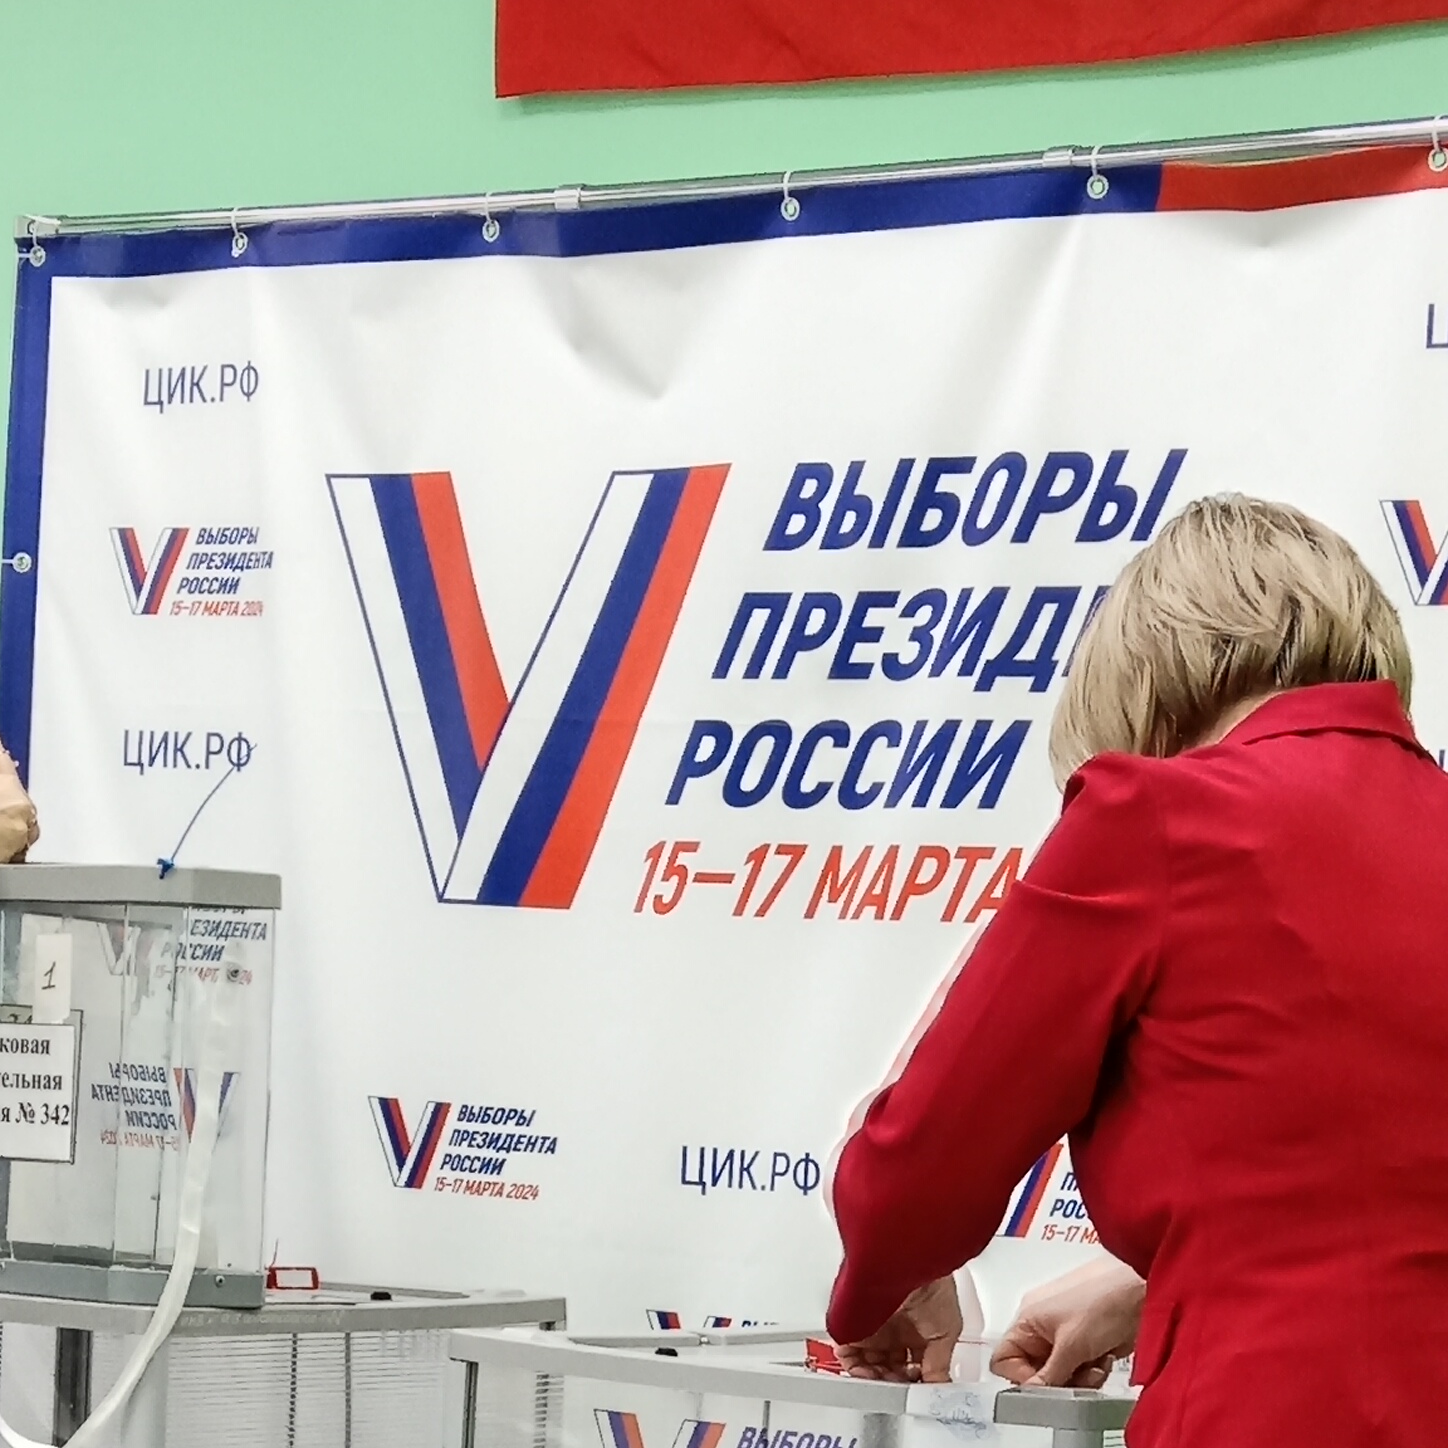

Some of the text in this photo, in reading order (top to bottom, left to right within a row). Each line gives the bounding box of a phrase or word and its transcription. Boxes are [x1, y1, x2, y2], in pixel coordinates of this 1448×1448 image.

[143, 361, 259, 414] ЦИК.РФ
[762, 449, 1188, 551] ВЫБОРЫ
[195, 526, 259, 546] ВЫБОРЫ
[186, 551, 274, 572] ПРЕЗИДЕНТА
[177, 577, 241, 595] РОССИИ
[201, 601, 239, 617] МАРТА
[123, 730, 251, 775] ЦИК.РФ
[665, 718, 1032, 810] РОССИИ
[803, 845, 1023, 923] МАРТА
[190, 919, 267, 941] ЕЗИДЕНТА
[15, 1102, 35, 1124] №
[40, 1104, 70, 1125] 342
[457, 1104, 536, 1127] ВЫБОРЫ
[449, 1129, 558, 1154] ПРЕЗИДЕНТА
[440, 1153, 507, 1175] РОССИИ
[680, 1144, 821, 1197] ЦИК.РФ
[463, 1179, 503, 1198] МАРТА
[506, 1183, 540, 1201] 2024
[1050, 1199, 1087, 1219] РОС
